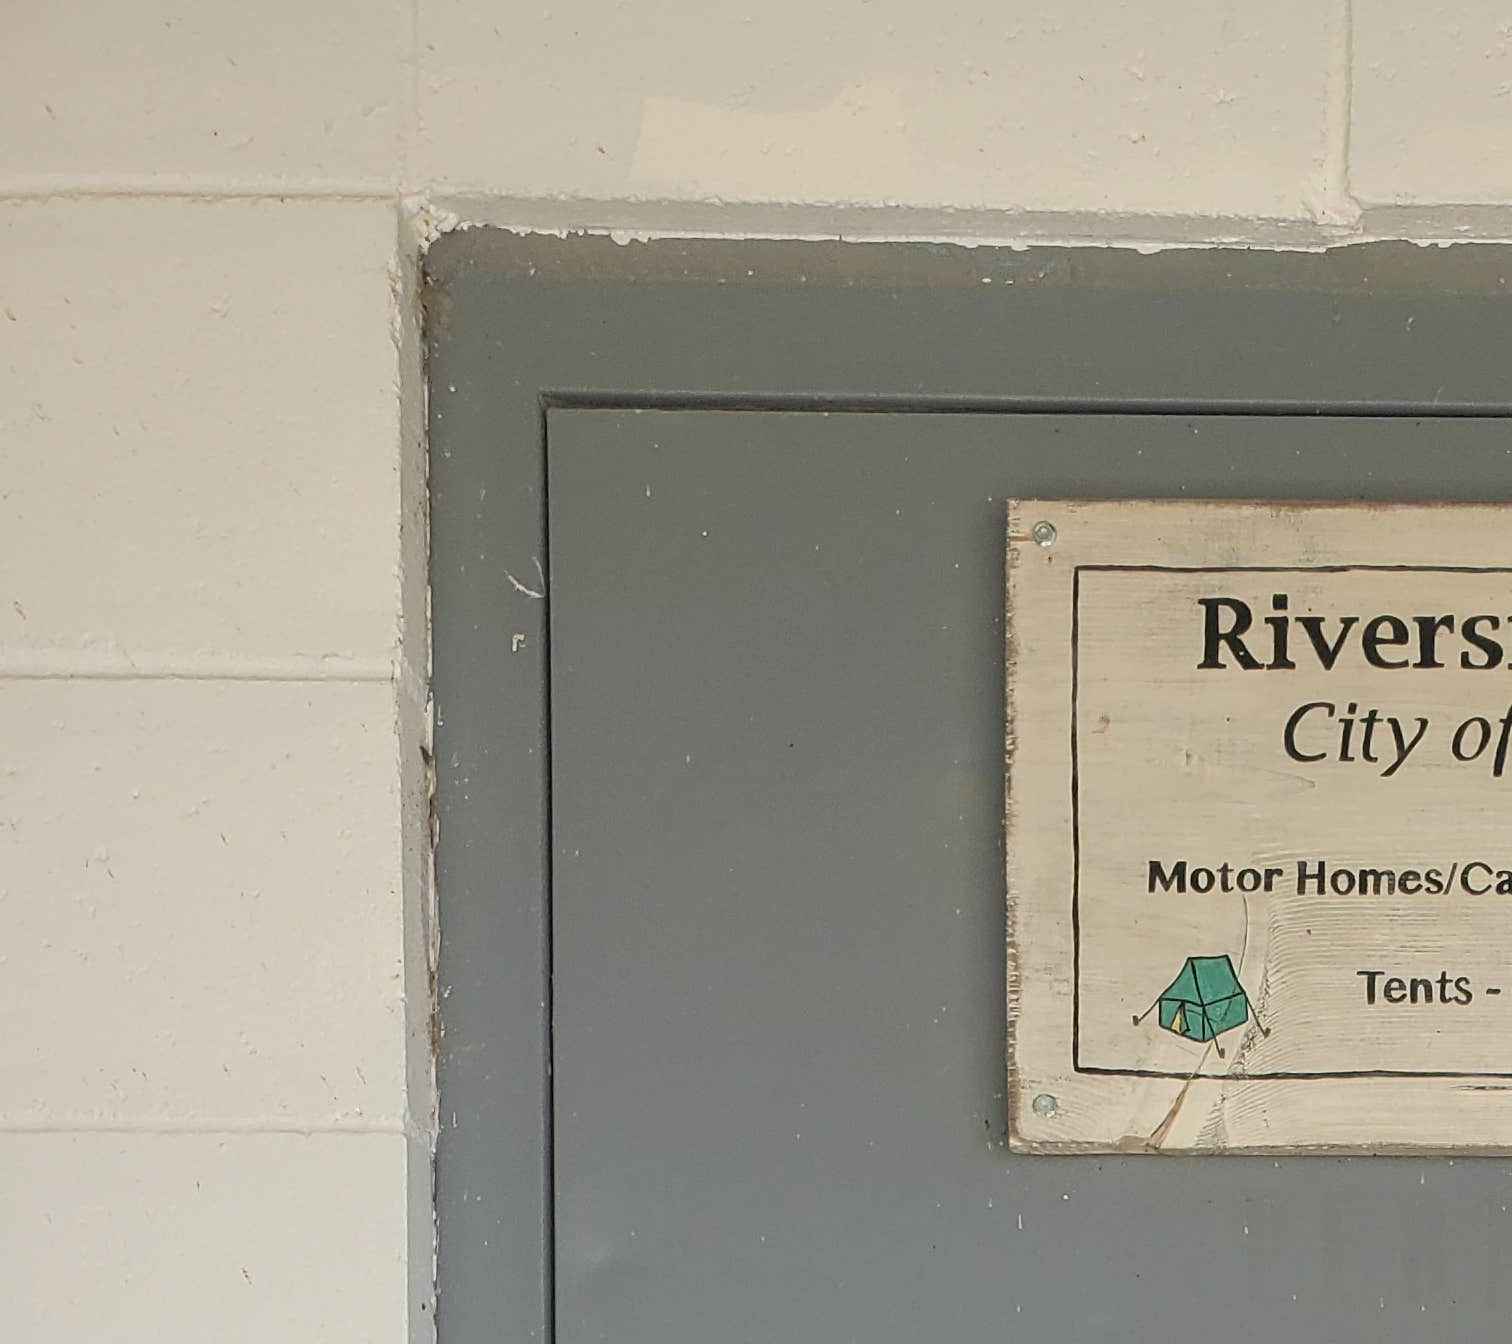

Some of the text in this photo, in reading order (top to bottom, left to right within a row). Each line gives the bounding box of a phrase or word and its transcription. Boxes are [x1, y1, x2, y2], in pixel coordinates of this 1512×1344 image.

[1284, 702, 1428, 777] City
[1149, 861, 1283, 893] Motor
[1357, 971, 1472, 1005] Tents
